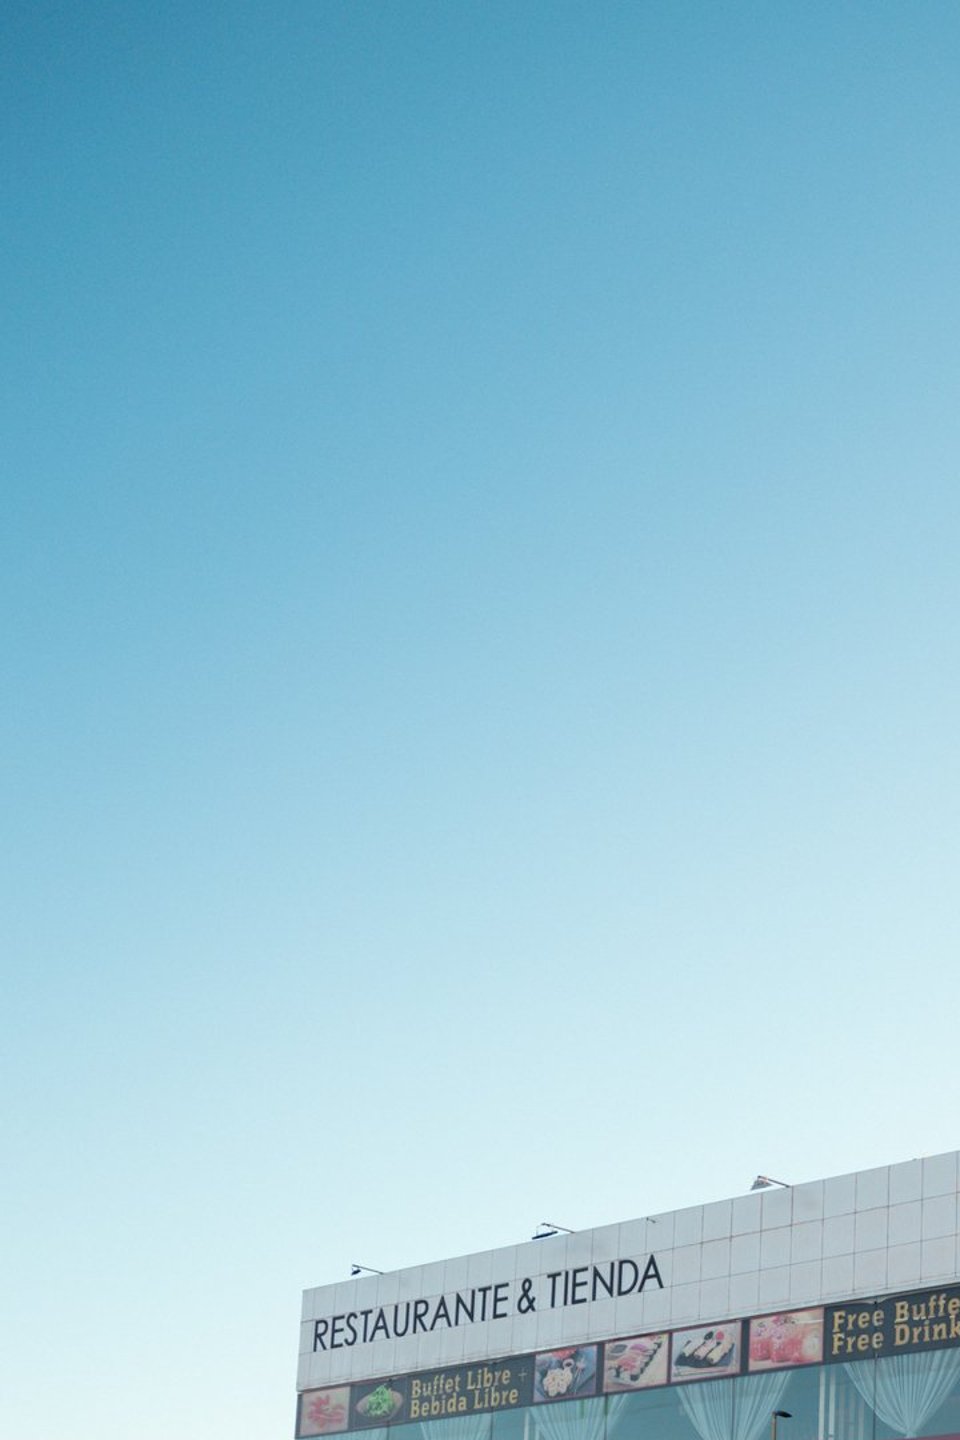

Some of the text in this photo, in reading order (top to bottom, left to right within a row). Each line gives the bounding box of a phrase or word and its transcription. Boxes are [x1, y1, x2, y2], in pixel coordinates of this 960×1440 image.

[313, 1254, 664, 1352] RESTAURANTE & TIENDA
[832, 1307, 885, 1334] Free
[832, 1329, 885, 1355] Free
[411, 1374, 461, 1398] Buffet
[467, 1367, 512, 1391] Libre
[410, 1385, 519, 1418] Bebida Libre
